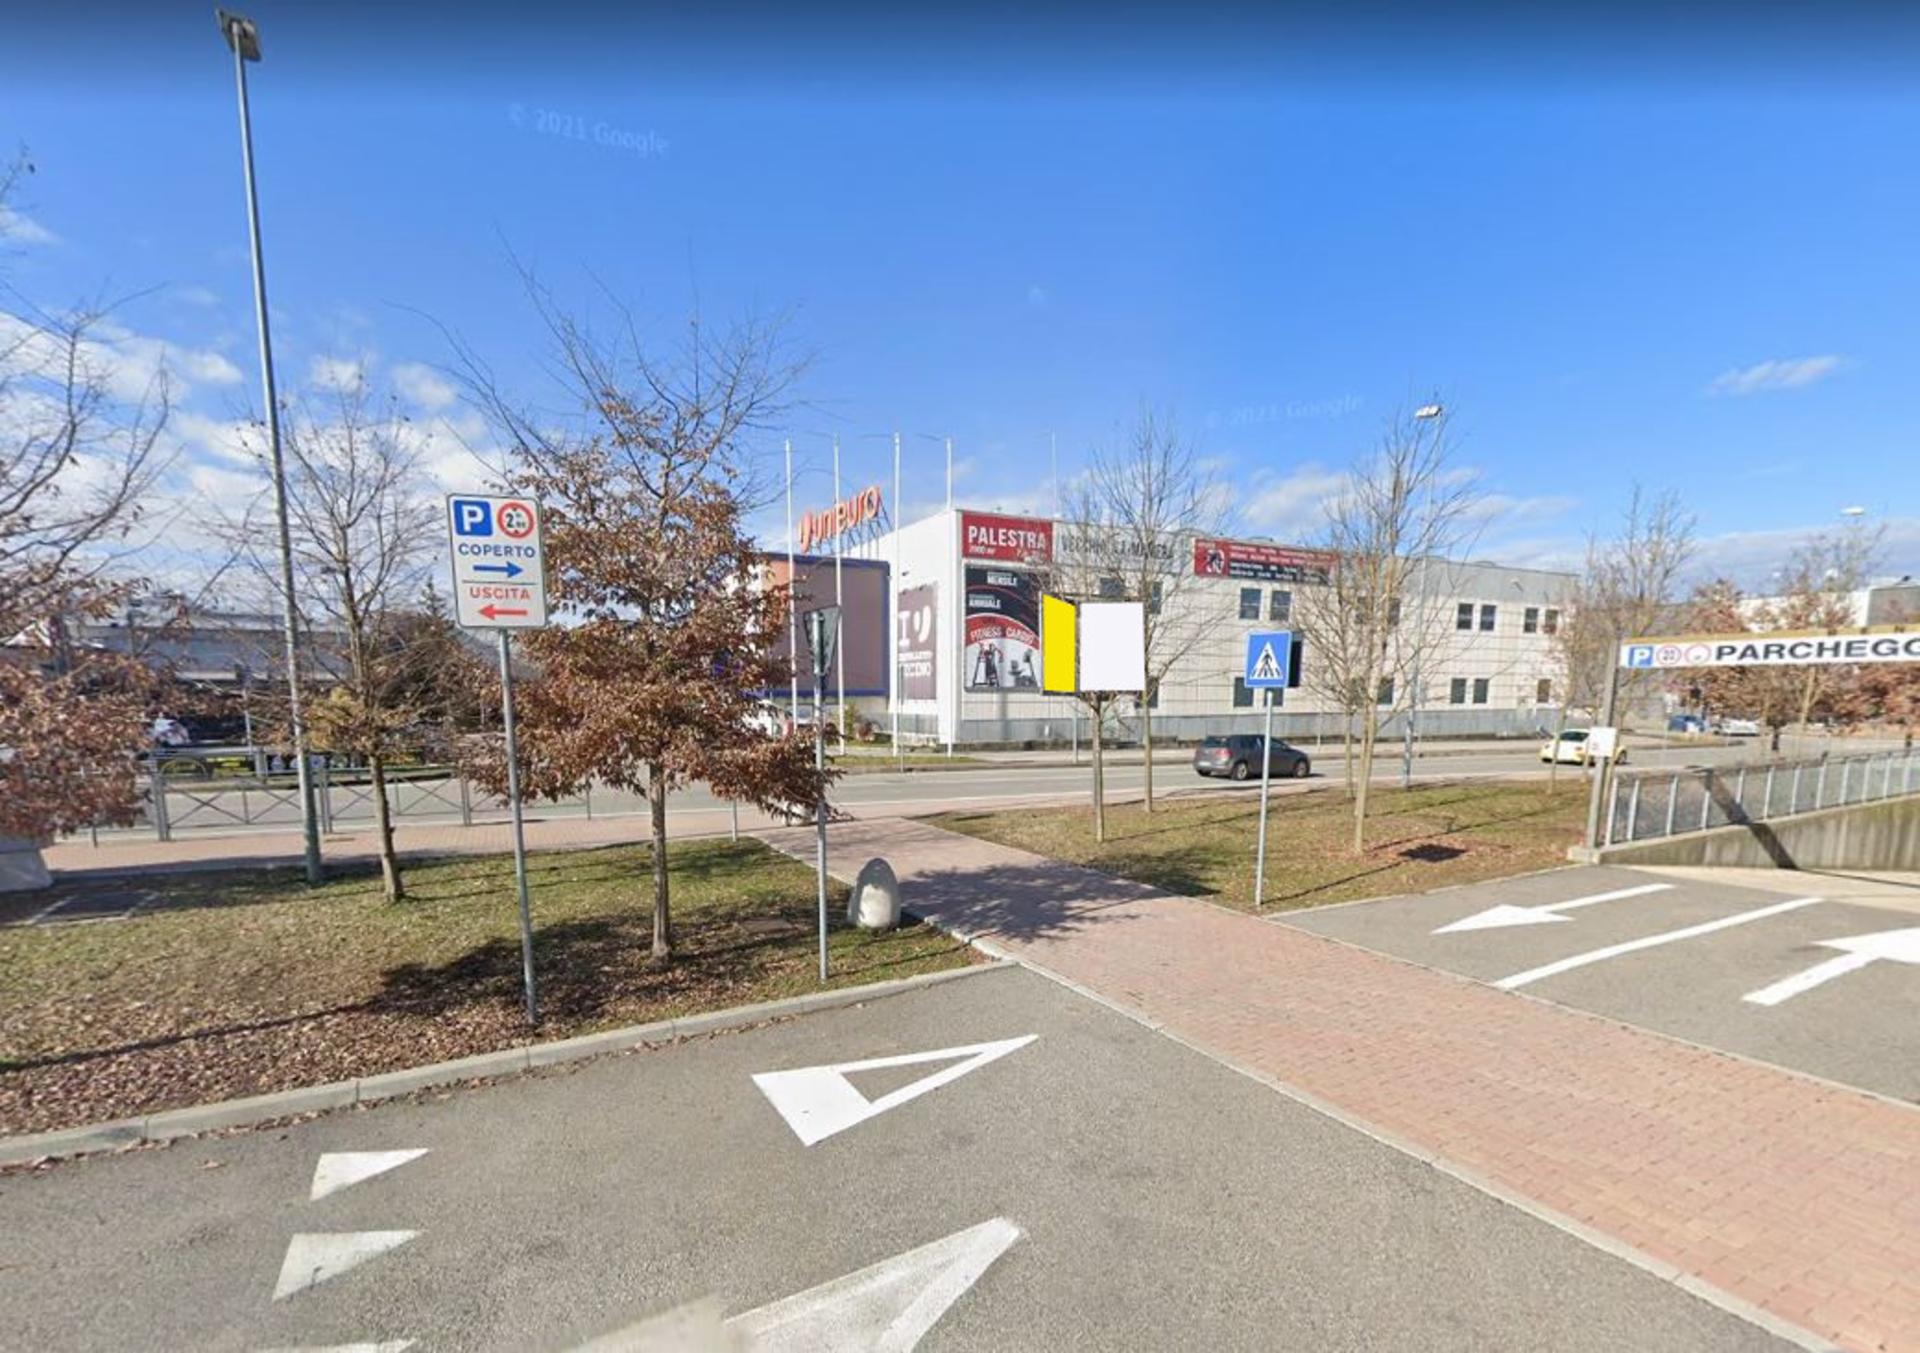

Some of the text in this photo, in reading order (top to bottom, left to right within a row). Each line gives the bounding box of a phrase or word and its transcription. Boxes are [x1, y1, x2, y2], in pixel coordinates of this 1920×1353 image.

[461, 505, 484, 532] P
[968, 525, 1047, 549] PALESTRA
[458, 543, 536, 558] COPERTO
[470, 587, 530, 599] USCITA
